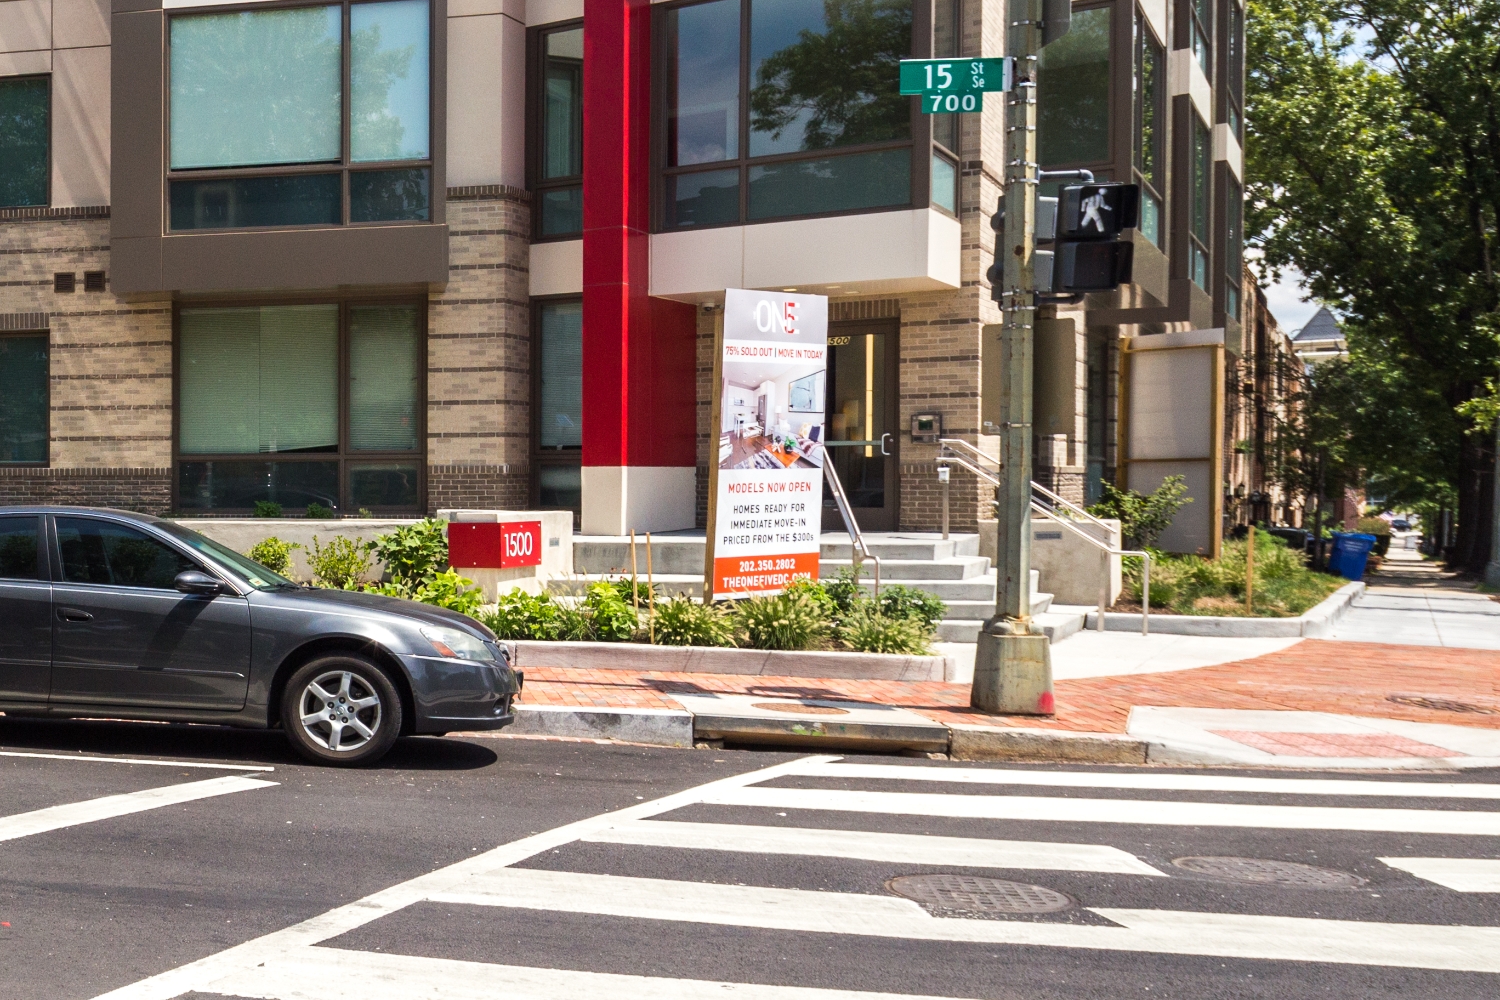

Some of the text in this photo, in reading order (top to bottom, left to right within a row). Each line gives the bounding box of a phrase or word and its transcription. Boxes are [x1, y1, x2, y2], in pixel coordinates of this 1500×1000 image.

[924, 62, 984, 89] 15 St
[972, 75, 985, 88] Se
[930, 94, 976, 112] 700
[725, 346, 824, 359] 75% SOLD OUT MOVE IN TODAY
[728, 481, 811, 494] MODELS NOW OPEN
[733, 503, 805, 514] HOMES READY FOR
[730, 518, 806, 529] IMMEDIATE MOVE-IN
[504, 531, 533, 557] 1500
[723, 532, 814, 545] PRICED FROM THE $300s
[739, 558, 796, 572] 202.350.2802
